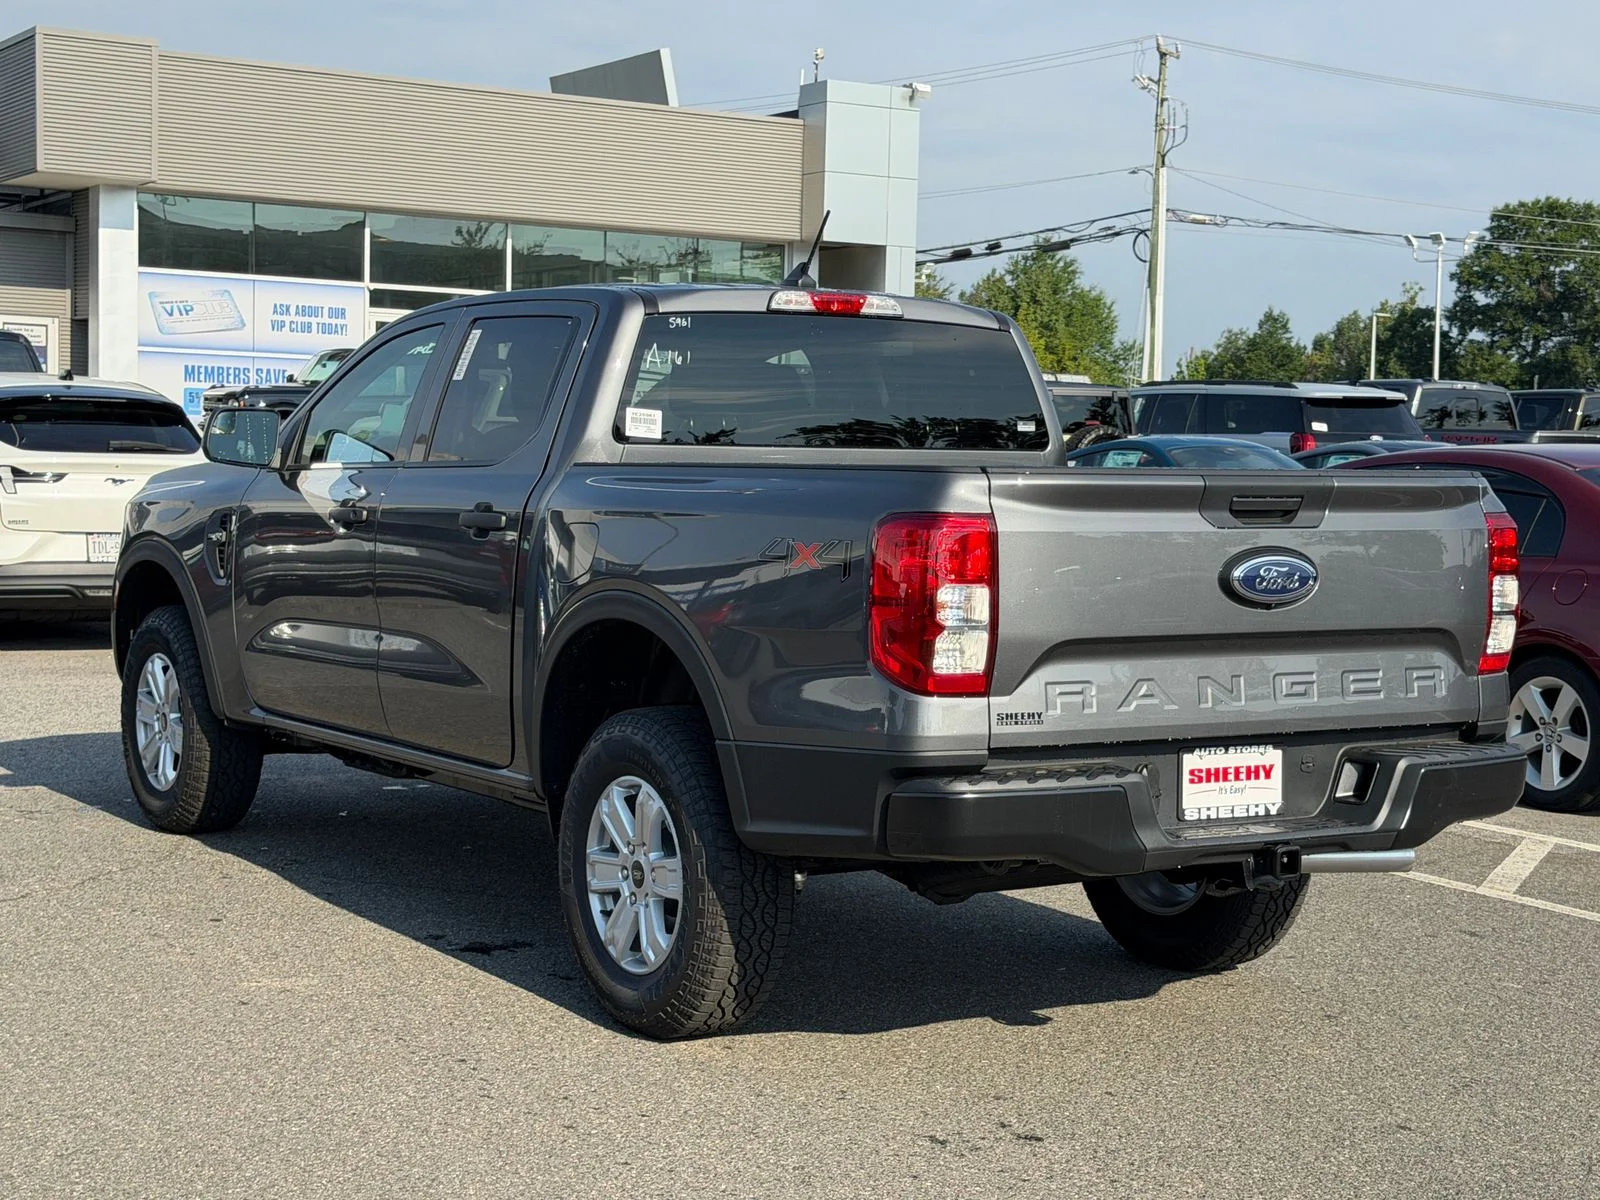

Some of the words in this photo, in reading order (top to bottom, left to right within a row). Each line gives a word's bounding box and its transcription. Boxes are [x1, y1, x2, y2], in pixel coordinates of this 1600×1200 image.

[161, 304, 194, 317] VIP
[272, 303, 291, 316] ASK
[294, 304, 325, 319] ABOUT
[327, 306, 347, 320] OUR
[270, 319, 286, 332] VIP
[289, 320, 313, 334] CLUB
[316, 322, 348, 336] TODAY!
[668, 316, 691, 329] 5961
[184, 364, 251, 384] MEMBERS
[1255, 565, 1301, 591] Ford
[1043, 664, 1448, 715] RANGER
[996, 711, 1044, 721] SHEEHY
[1193, 747, 1226, 756] AUTO
[1228, 744, 1275, 755] STORES
[1188, 764, 1275, 785] SHEEHY
[1218, 785, 1228, 795] It's
[1229, 784, 1247, 796] Easy!
[1184, 802, 1282, 821] SHEEHY
